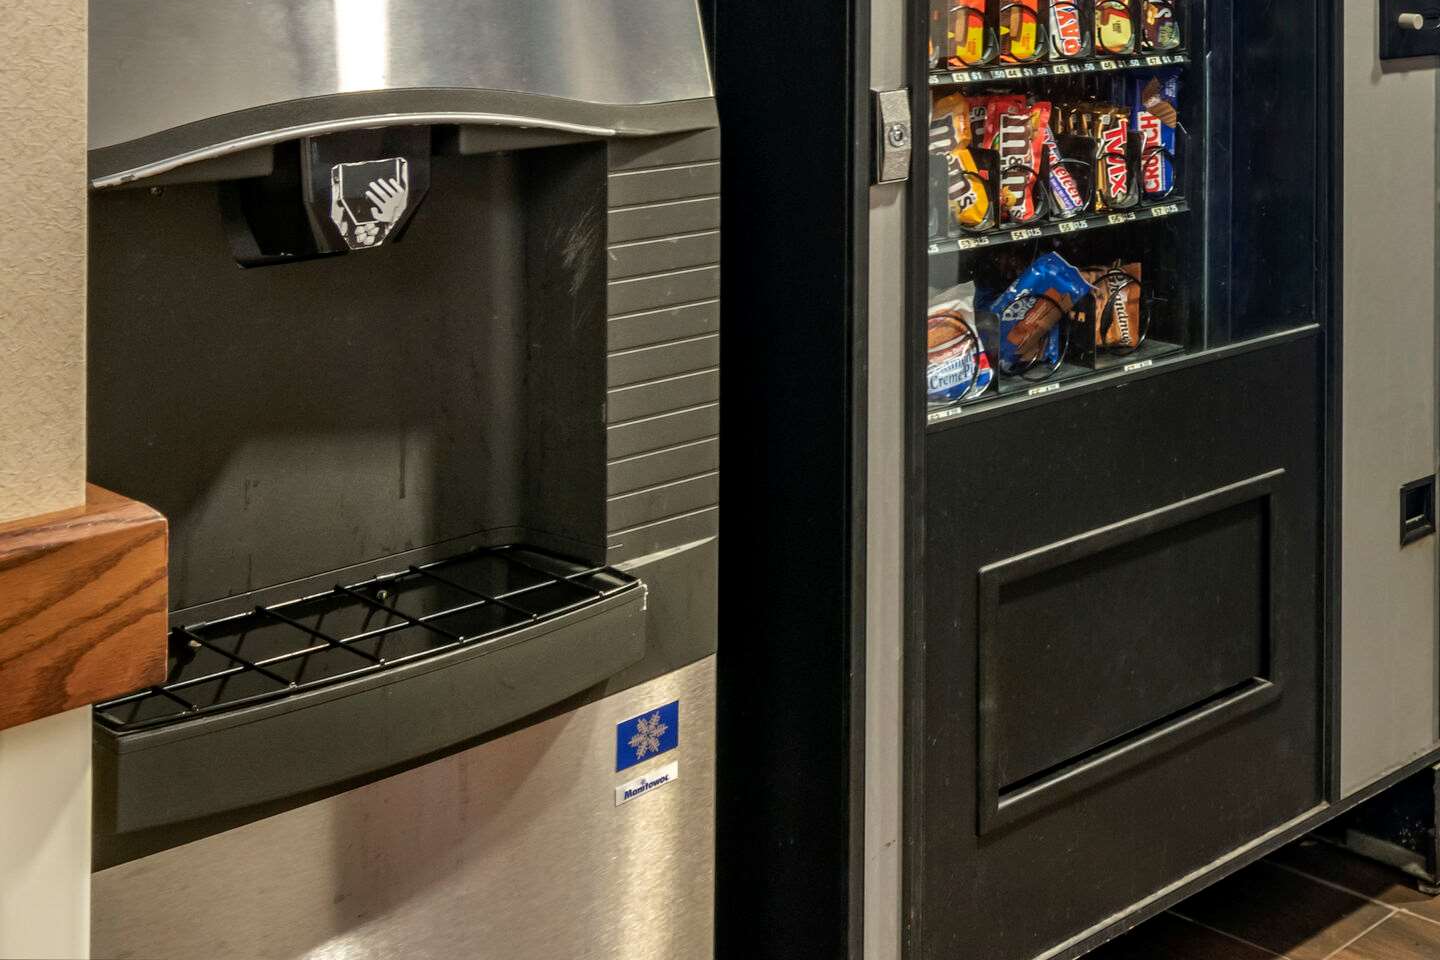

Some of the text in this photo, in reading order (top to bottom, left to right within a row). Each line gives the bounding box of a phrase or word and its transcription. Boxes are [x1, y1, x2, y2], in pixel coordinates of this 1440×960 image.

[1103, 118, 1128, 198] TWIX
[1141, 113, 1161, 193] CRUNCH
[930, 372, 962, 390] Creme
[624, 773, 670, 801] Manitowoc
